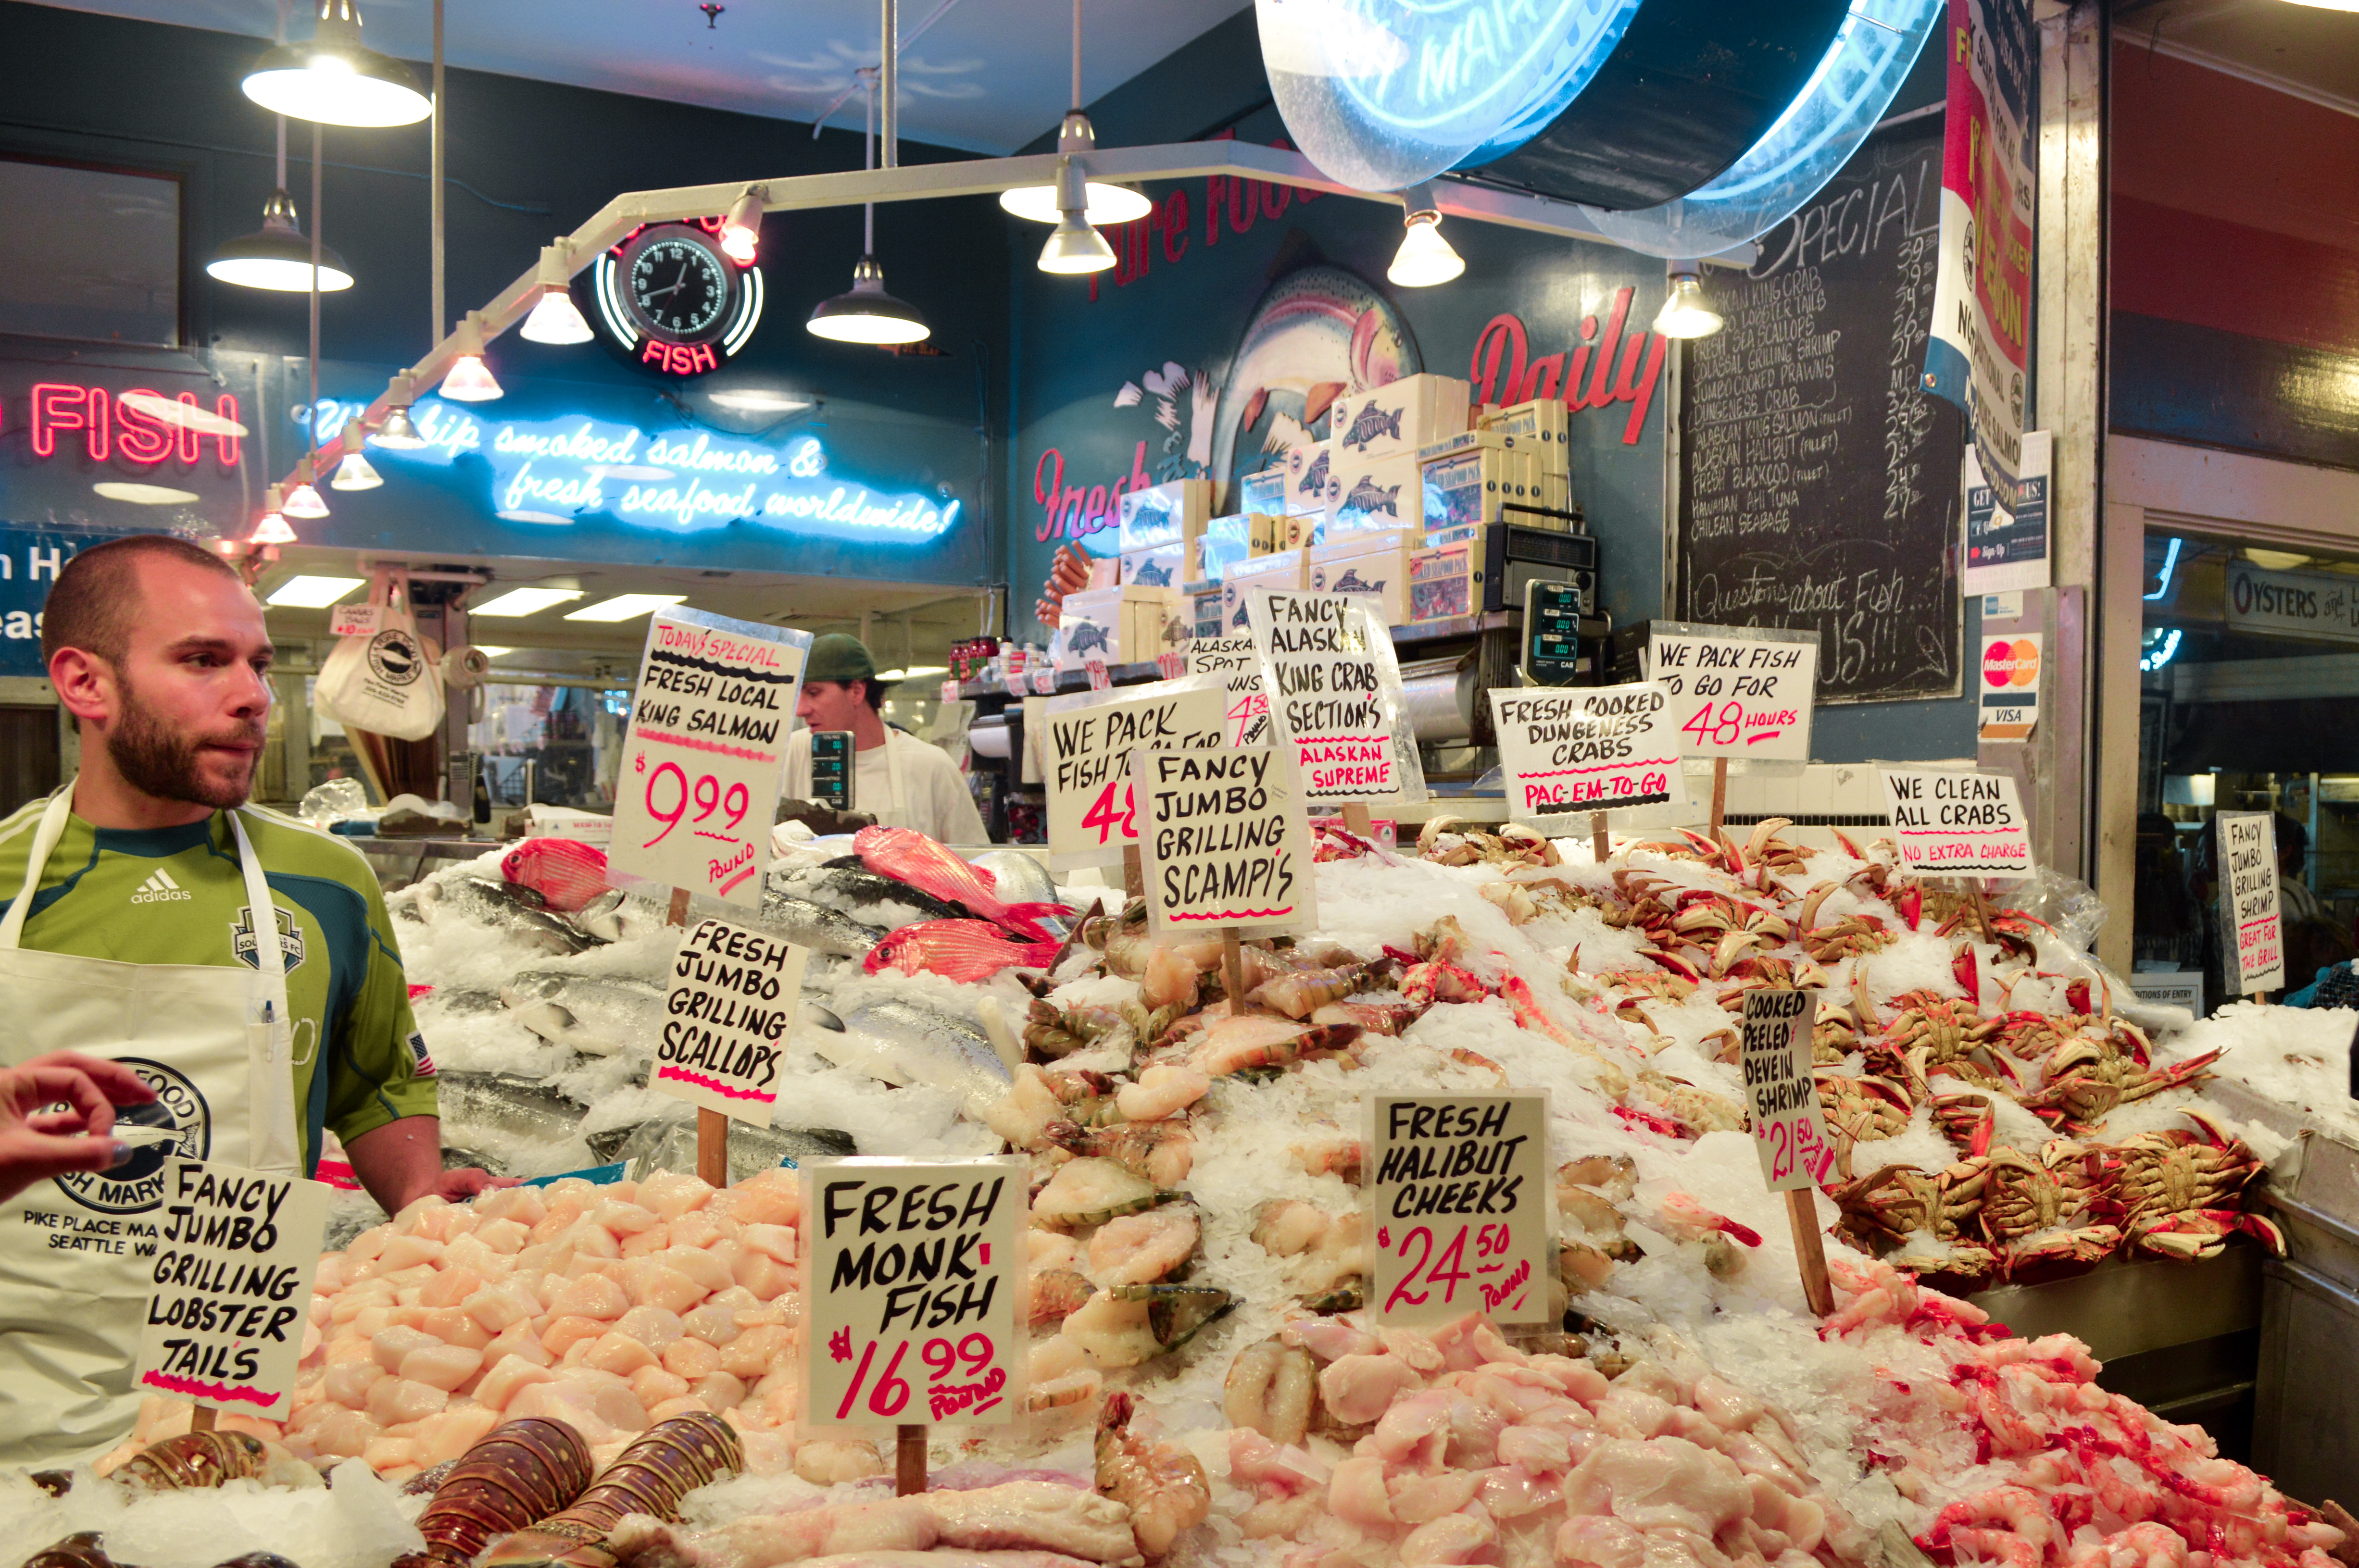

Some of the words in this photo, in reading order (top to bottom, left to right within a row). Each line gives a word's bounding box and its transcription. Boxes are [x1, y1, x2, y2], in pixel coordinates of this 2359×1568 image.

[1748, 161, 1940, 280] SPECIAL
[641, 262, 653, 275] 10
[653, 250, 664, 262] 11
[669, 248, 684, 261] 12
[690, 255, 697, 267] 1
[638, 278, 647, 290] 9
[702, 268, 711, 281] 2
[1753, 276, 1781, 305] KING
[1783, 266, 1821, 298] CRAB
[642, 295, 651, 307] 8
[702, 301, 711, 313] 4
[706, 286, 715, 298] 3
[1794, 289, 1826, 314] TAILS
[655, 309, 664, 320] 7
[673, 317, 681, 328] 6
[690, 313, 699, 324] 5
[1693, 336, 1725, 362] FRESH
[1733, 328, 1755, 353] SEA
[1757, 314, 1815, 347] SCALLOPS
[1797, 330, 1841, 360] SHRIMP
[642, 339, 717, 374] FISH
[1471, 286, 1667, 445] Daily
[1734, 368, 1775, 396] COOKED
[1781, 354, 1834, 385] PRAWNS
[1694, 393, 1758, 426] DUNGENESS
[1766, 386, 1799, 412] CRAB
[32, 383, 240, 466] FISH
[1745, 415, 1769, 438] KING
[1772, 409, 1818, 435] SALMON
[494, 422, 640, 464] smoked
[646, 434, 779, 476] salmon
[791, 438, 821, 477] &
[1746, 432, 1800, 463] HALIBUT
[505, 460, 606, 510] fresh
[621, 478, 756, 525] seafood
[766, 486, 961, 535] worldwide!
[1768, 484, 1799, 508] TUNA
[1973, 489, 1991, 507] GET
[2025, 482, 2041, 498] US!
[1691, 515, 1733, 541] CHILEAN
[1739, 508, 1790, 535] SEABASS
[1696, 566, 1790, 619] Questions
[1789, 574, 1846, 612] about
[2234, 572, 2318, 619] OYSTERS
[1268, 595, 1348, 629] FANCY
[708, 639, 780, 668] SPECIAL
[1660, 642, 1691, 667] WE
[1696, 644, 1746, 668] PACK
[1750, 648, 1801, 669] FISH
[1984, 658, 2037, 671] MasterCard
[643, 666, 714, 697] FRESH
[717, 680, 781, 710] LOCAL
[1274, 661, 1323, 697] KING
[1331, 662, 1379, 692] CRAB
[1657, 674, 1682, 696] TO
[1695, 674, 1723, 697] GO
[1732, 675, 1779, 698] FOR
[636, 699, 681, 727] KING
[687, 709, 780, 745] SALMON
[1500, 698, 1572, 725] FRESH
[1583, 691, 1664, 716] COOKED
[1682, 700, 1743, 746] 48
[1745, 709, 1798, 728] HOURS
[1996, 709, 2021, 722] VISA
[1054, 718, 1097, 759] WE
[1107, 702, 1177, 747] PACK
[1527, 712, 1654, 745] DUNGENESS
[1300, 745, 1381, 767] ALASKAN
[1552, 737, 1633, 766] CRABS
[1057, 756, 1109, 794] FISH
[1158, 751, 1270, 787] FANCY
[1312, 762, 1391, 789] SUPREME
[1155, 786, 1267, 822] JUMBO
[1890, 775, 1922, 800] WE
[1935, 777, 2000, 800] CLEAN
[1895, 805, 1931, 826] ALL
[1940, 804, 2011, 826] CRABS
[1156, 815, 1285, 861] GRILLING
[2232, 821, 2262, 846] FANCY
[708, 843, 755, 883] POUND
[1903, 844, 1921, 862] NO
[1930, 843, 1974, 861] EXTRA
[1981, 843, 2027, 859] CHARGE
[2232, 848, 2262, 873] JUMBO
[131, 888, 191, 904] adidas
[2235, 868, 2271, 896] GRILLING
[2241, 891, 2274, 919] SHRIMP
[290, 944, 301, 955] FC
[690, 921, 788, 972] FRESH
[2240, 929, 2261, 950] GREAT
[2263, 924, 2276, 941] FOR
[676, 950, 780, 1000] JUMBO
[2242, 955, 2255, 972] THE
[2258, 945, 2278, 966] GRILL
[1746, 991, 1806, 1021] COOKED
[2162, 990, 2171, 999] OF
[2172, 990, 2192, 998] ENTRY
[668, 987, 787, 1041] GRILLING
[1743, 1021, 1790, 1053] PEELED
[1744, 1050, 1794, 1087] DEVEIN
[1757, 1076, 1812, 1118] SHRIMP
[1390, 1101, 1511, 1140] FRESH
[1376, 1134, 1528, 1185] HALIBUT
[1804, 1135, 1824, 1179] POUND
[178, 1164, 291, 1224] FANCY
[824, 1176, 1005, 1239] FRESH
[1392, 1175, 1524, 1219] CHEEKS
[24, 1210, 59, 1228] PIKE
[63, 1216, 121, 1234] PLACE
[164, 1206, 278, 1253] JUMBO
[48, 1234, 126, 1255] SEATTLE
[153, 1250, 300, 1301] GRILLING
[1480, 1258, 1531, 1314] POUND
[148, 1294, 298, 1343] LOBSTER
[879, 1275, 999, 1335] FISH
[929, 1367, 1006, 1421] POUND
